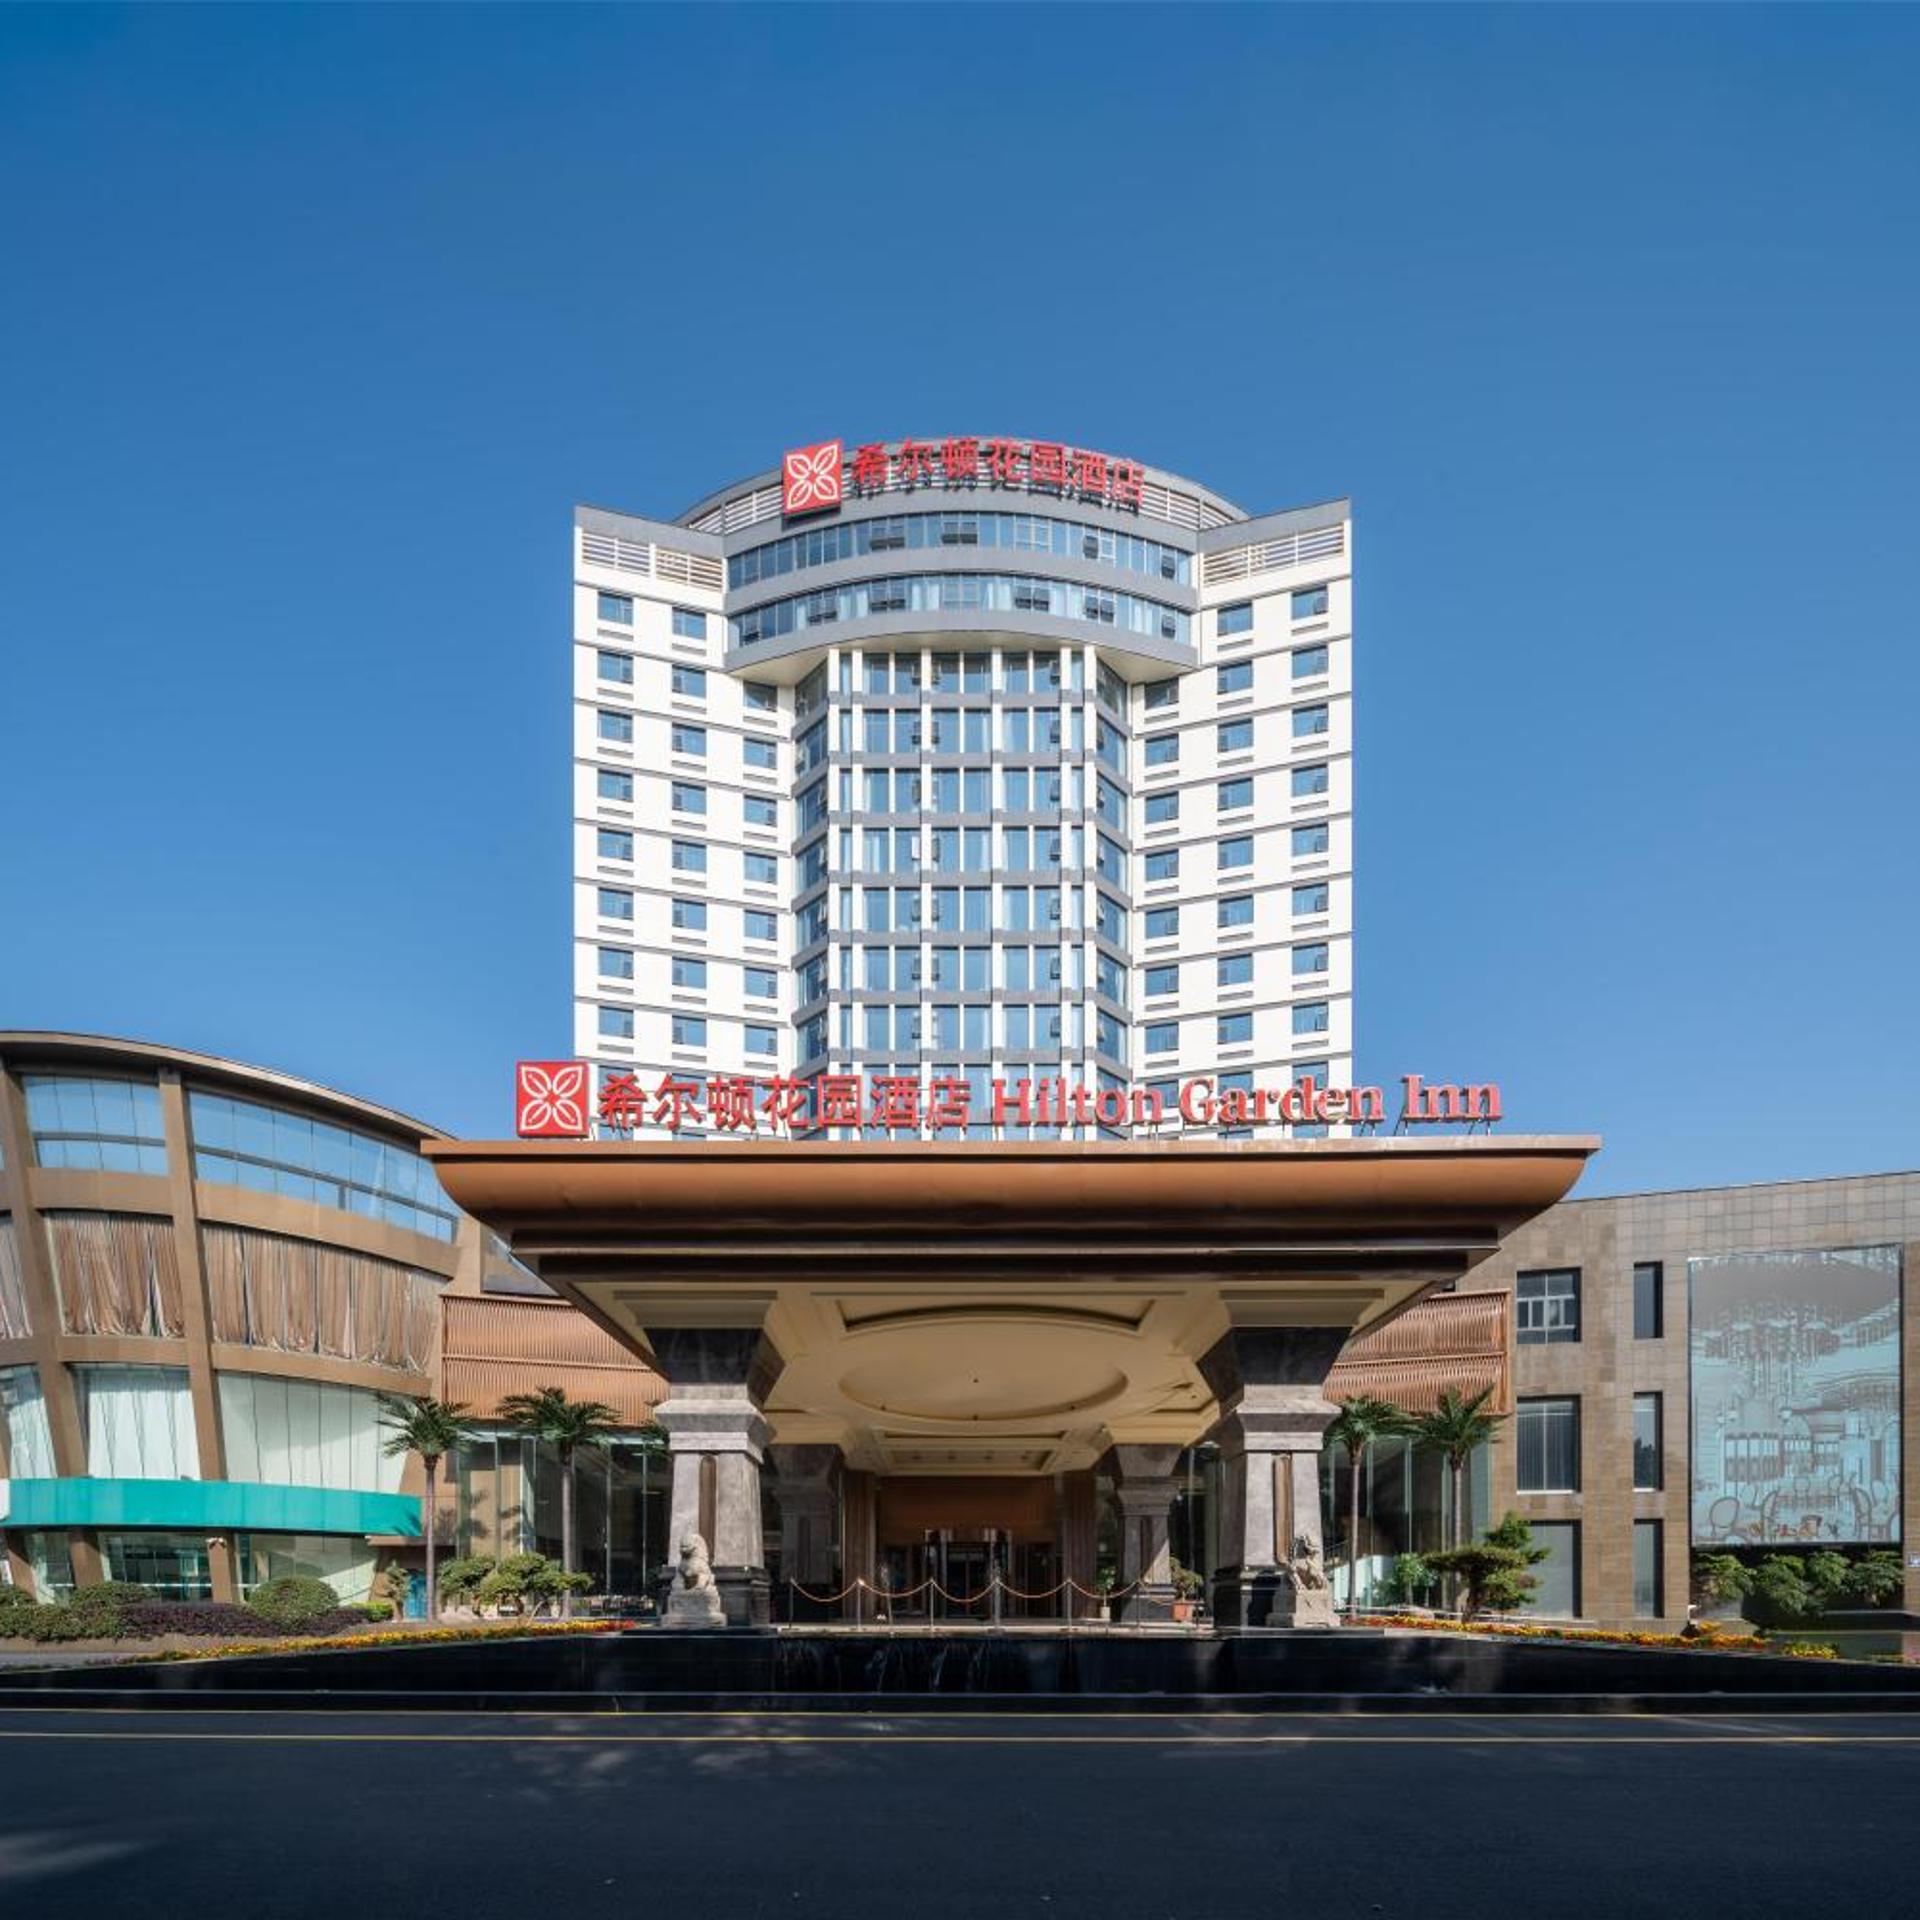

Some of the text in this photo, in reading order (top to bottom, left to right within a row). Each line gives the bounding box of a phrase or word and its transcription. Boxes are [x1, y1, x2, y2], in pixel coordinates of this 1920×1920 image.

[852, 437, 1145, 508] 希尔顿花园酒店
[599, 1073, 971, 1130] 希尔顿花园酒店
[992, 1074, 1502, 1125] Hilton Garden Inn
